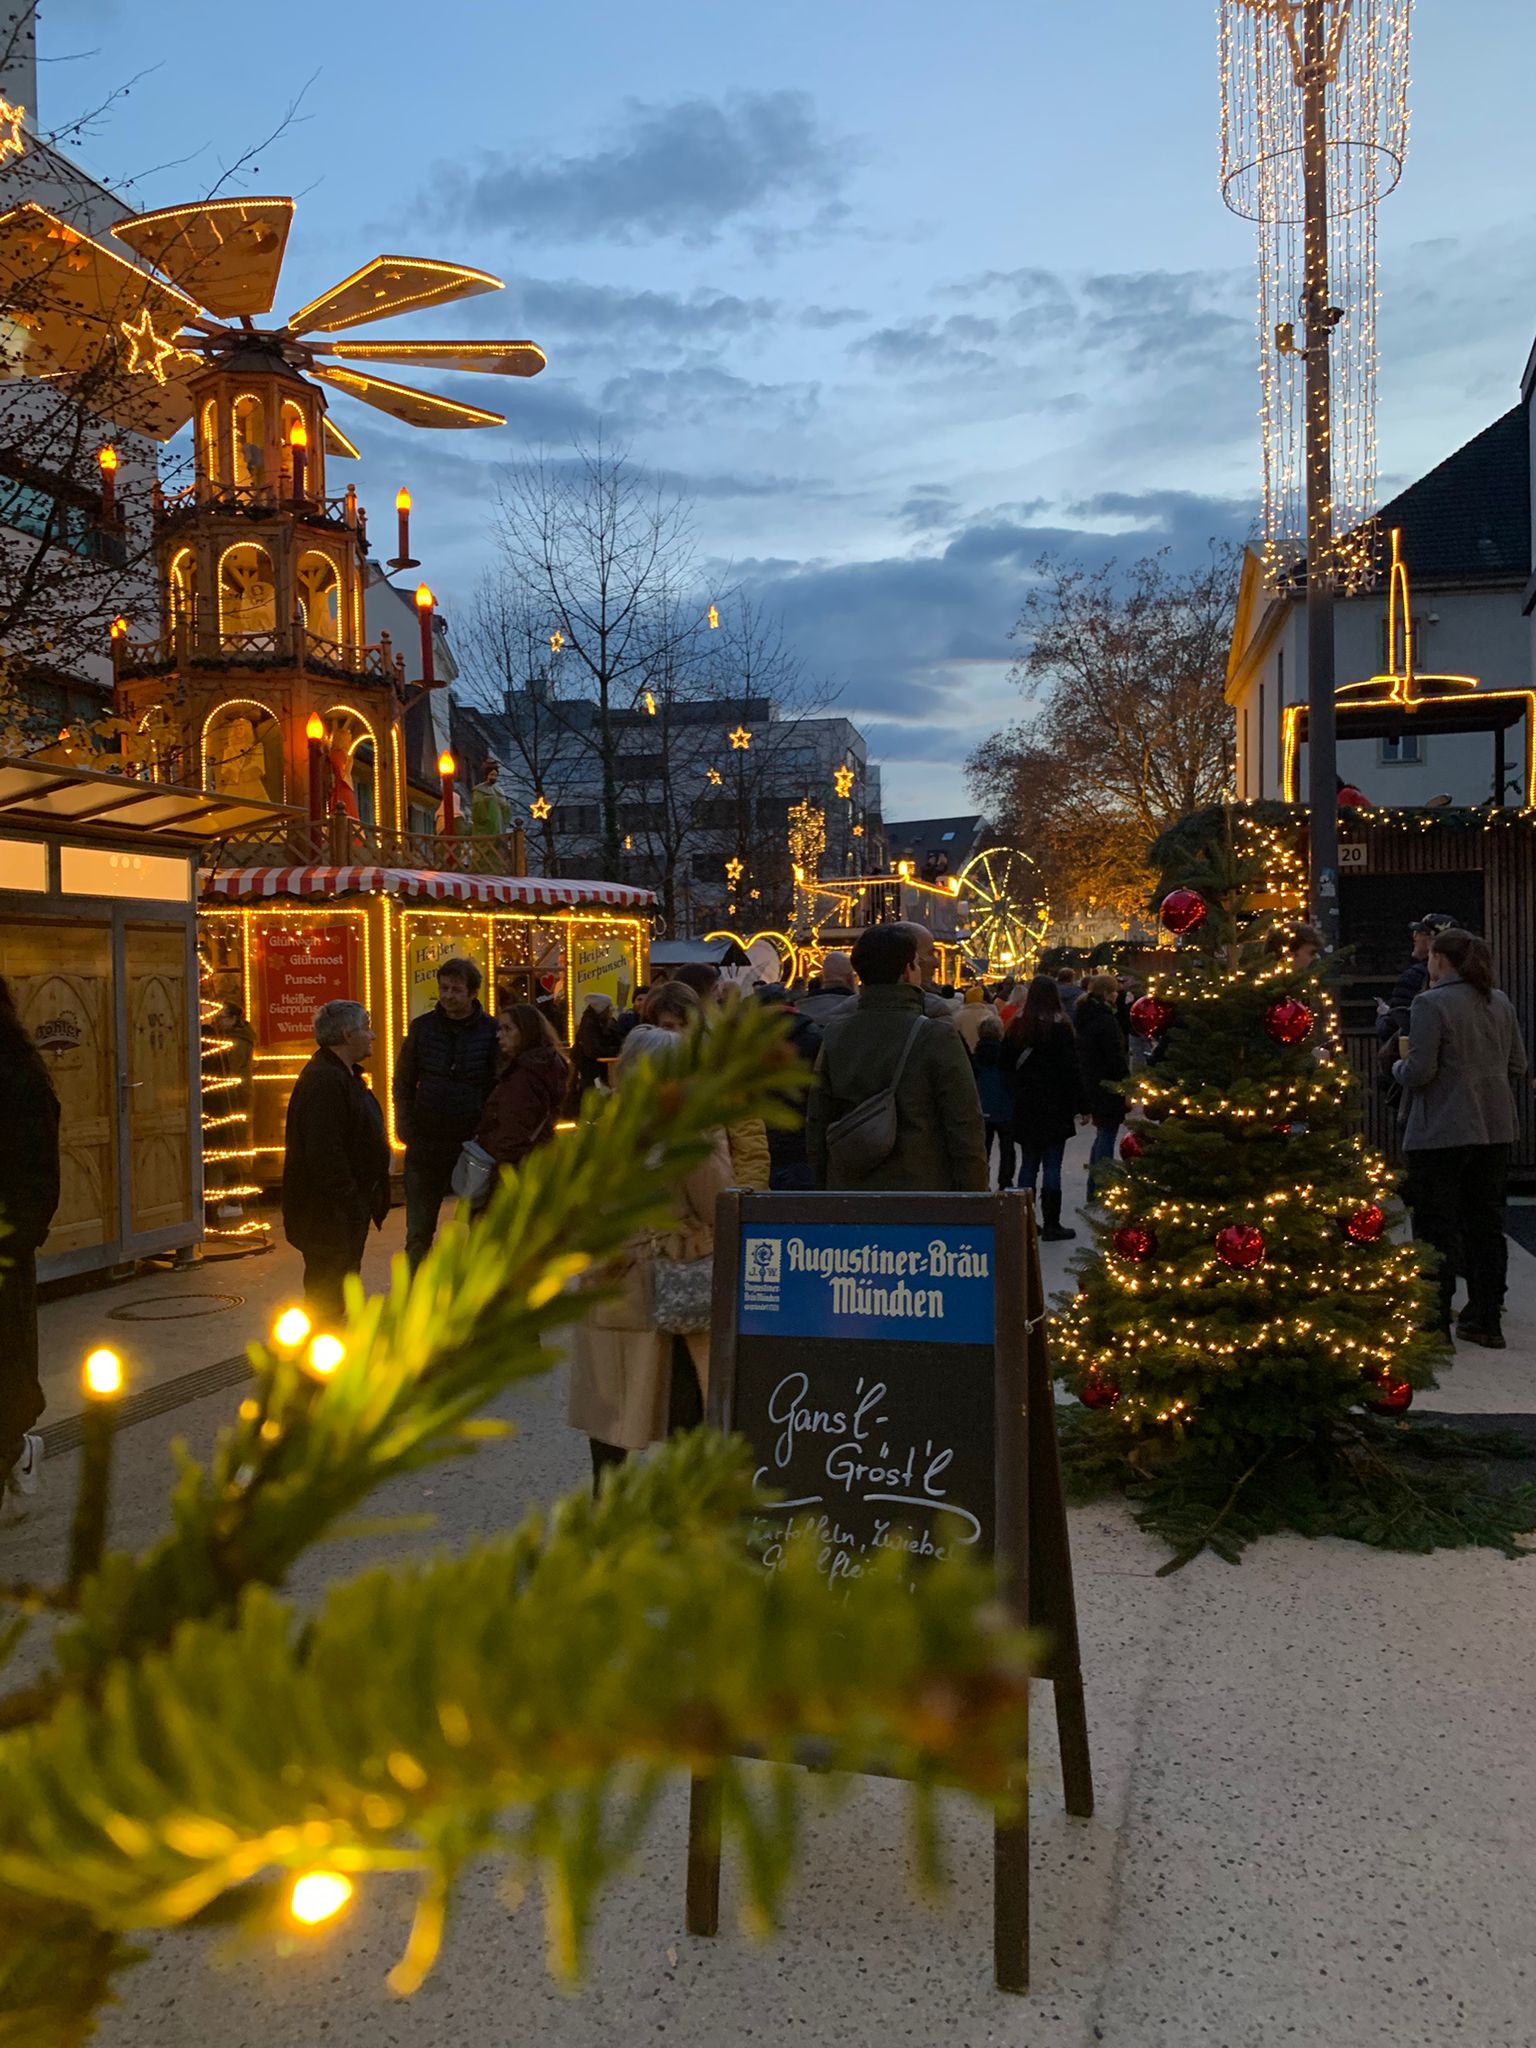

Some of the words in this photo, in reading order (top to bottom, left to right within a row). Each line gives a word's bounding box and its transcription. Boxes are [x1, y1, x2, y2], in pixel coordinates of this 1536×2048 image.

[1342, 849, 1361, 861] 20
[290, 954, 343, 965] Glühmost
[577, 955, 627, 983] Eierpunsch
[285, 974, 326, 985] Punsch
[281, 993, 316, 1004] Heißer
[829, 1276, 944, 1318] München
